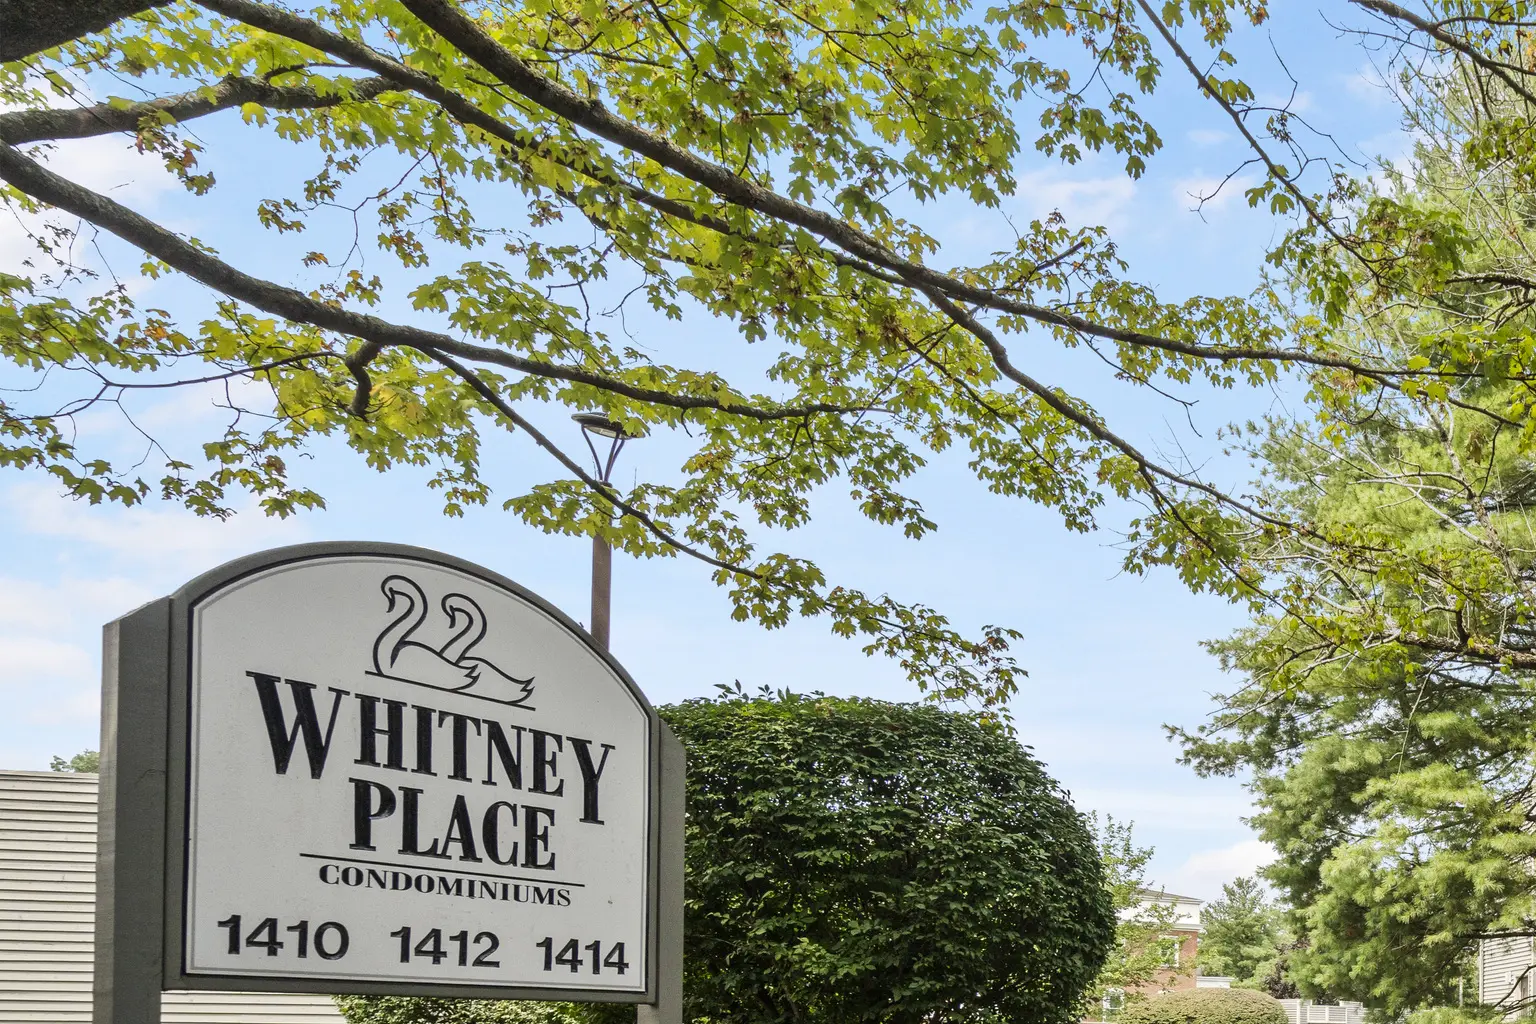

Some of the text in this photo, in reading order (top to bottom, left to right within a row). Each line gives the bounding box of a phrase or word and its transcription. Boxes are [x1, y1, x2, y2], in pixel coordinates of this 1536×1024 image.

[245, 670, 617, 826] WHITNEY
[348, 777, 557, 872] PLACE
[318, 863, 573, 908] CONDOMINIUMS
[217, 913, 630, 976] 1410 1412 1414
